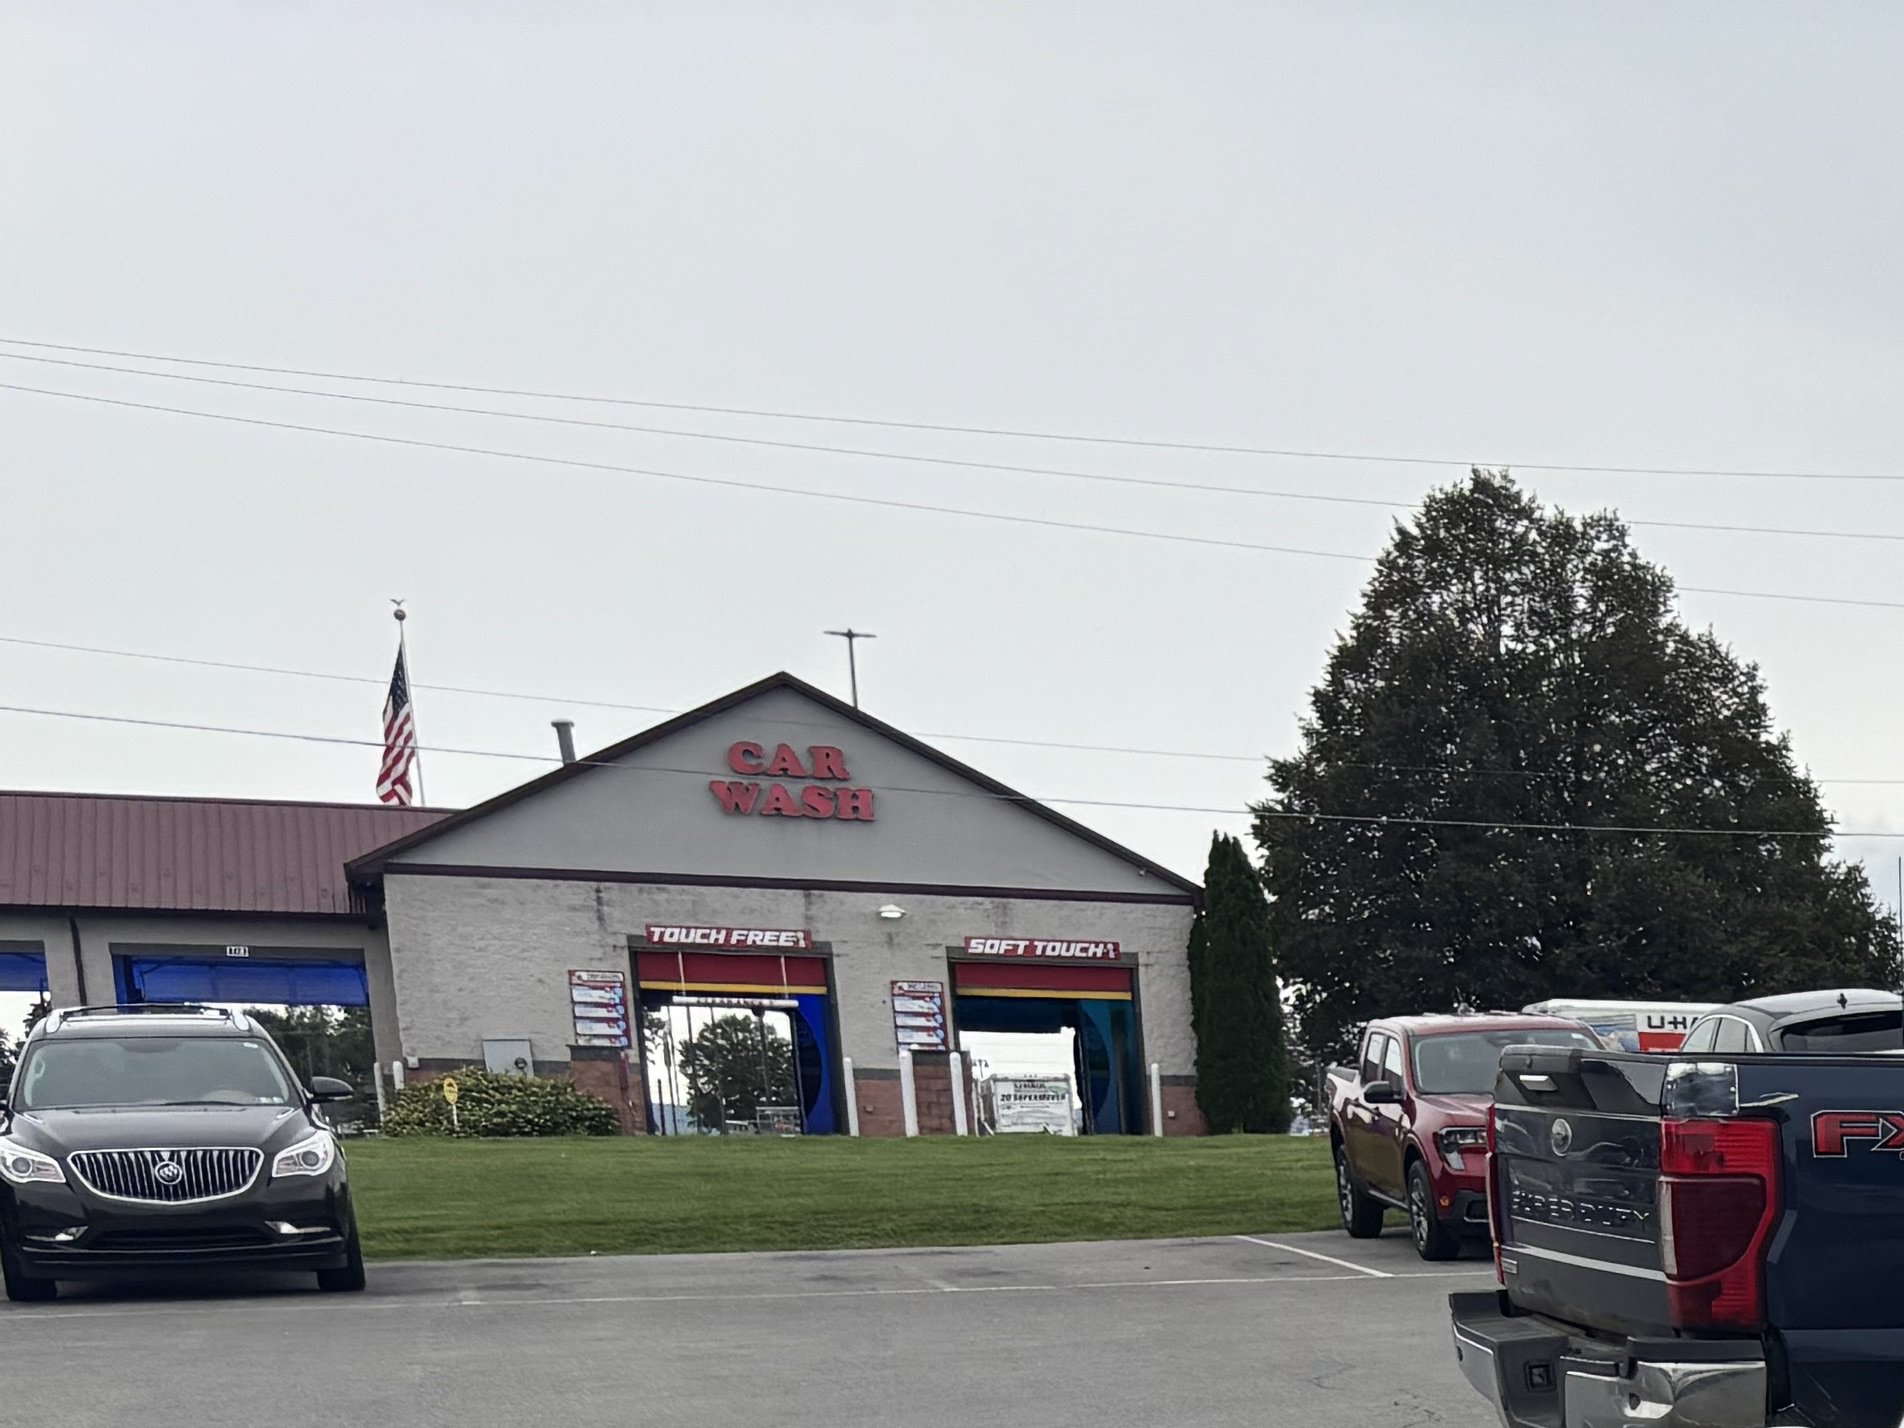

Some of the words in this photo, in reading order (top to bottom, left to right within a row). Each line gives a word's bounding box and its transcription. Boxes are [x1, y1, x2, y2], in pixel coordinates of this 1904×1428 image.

[728, 741, 850, 780] CAR
[709, 780, 876, 821] WASH
[650, 927, 726, 944] TOUCH
[730, 930, 795, 947] FREE
[968, 939, 1029, 955] SOFT
[1034, 941, 1104, 958] TOUCH
